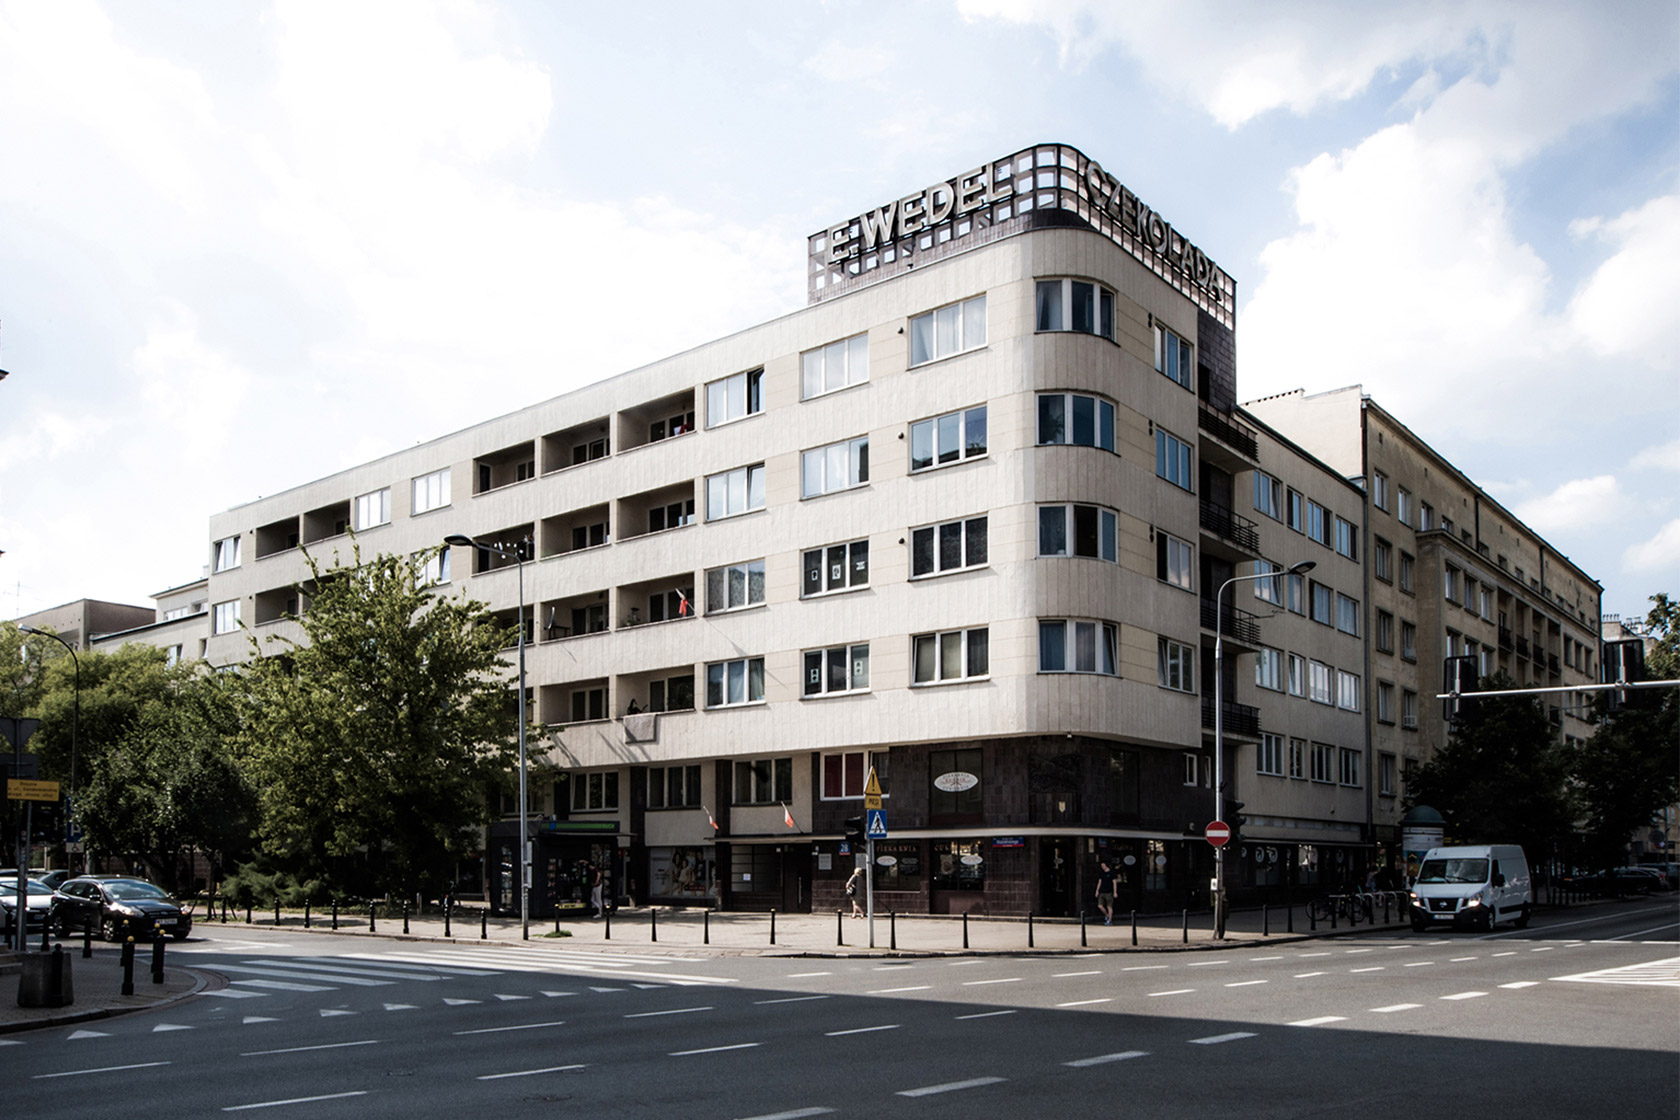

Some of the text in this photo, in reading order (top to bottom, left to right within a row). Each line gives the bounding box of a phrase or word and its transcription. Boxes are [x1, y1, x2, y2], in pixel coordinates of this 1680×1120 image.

[827, 161, 1014, 264] E. WEDEL
[1085, 160, 1222, 302] CZEKOLADA
[840, 843, 849, 853] 28
